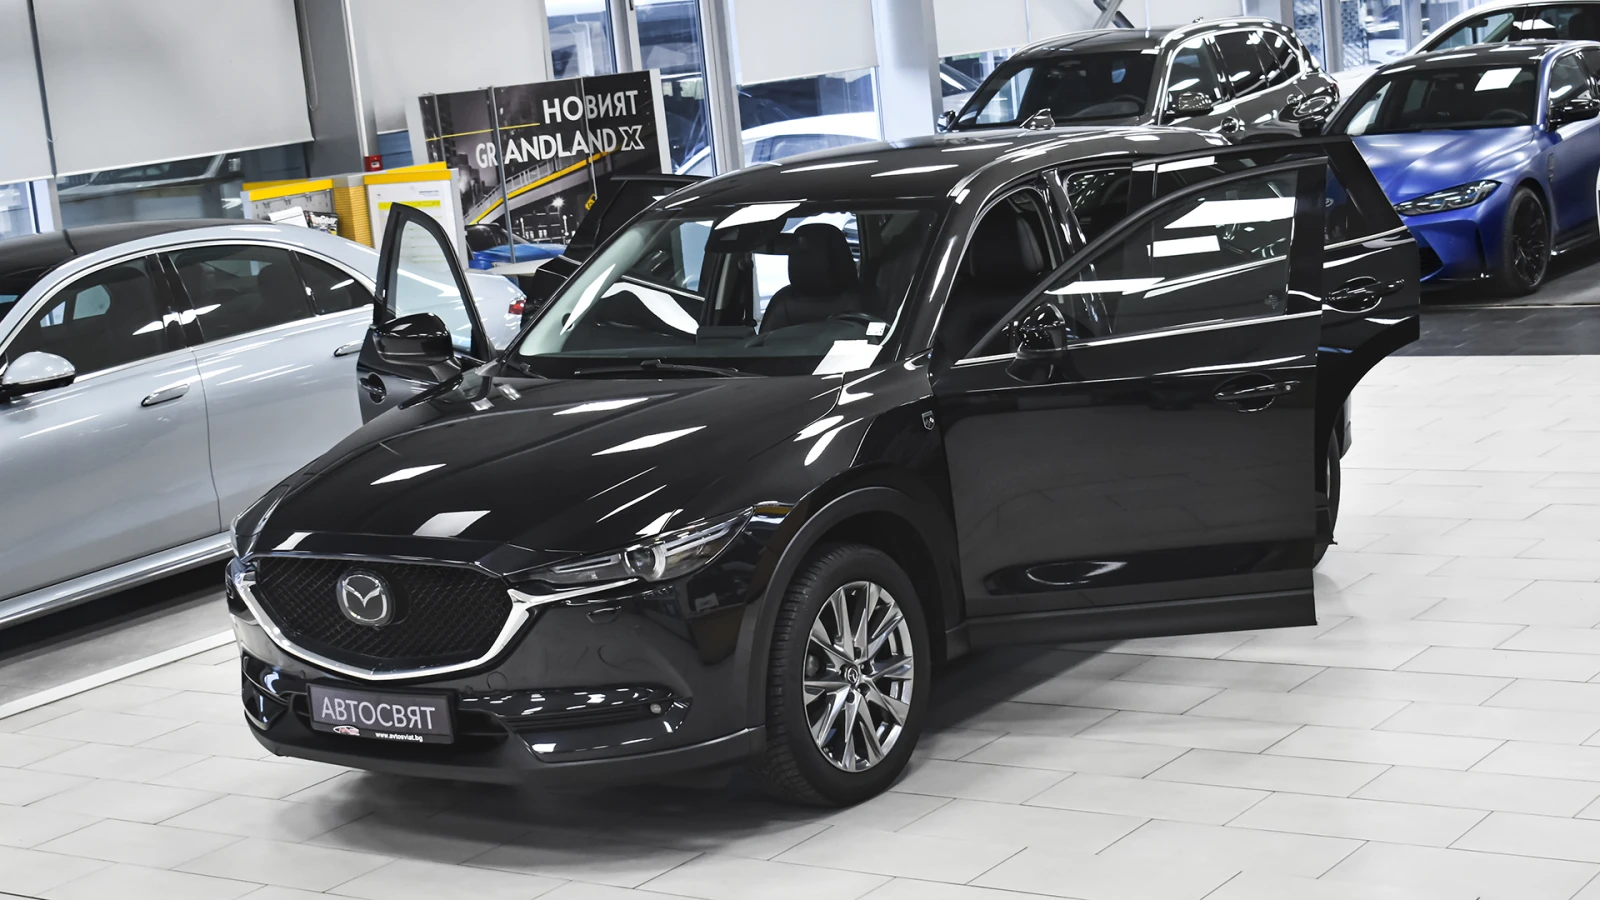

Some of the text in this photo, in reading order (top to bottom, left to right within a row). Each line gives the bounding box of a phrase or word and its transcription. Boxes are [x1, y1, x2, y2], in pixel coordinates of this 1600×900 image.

[542, 90, 638, 124] НОВИЯТ
[475, 125, 645, 168] GRANDLAND X
[321, 696, 436, 730] АВТОСВЯТ
[375, 731, 423, 743] www.avtosviat.bg
